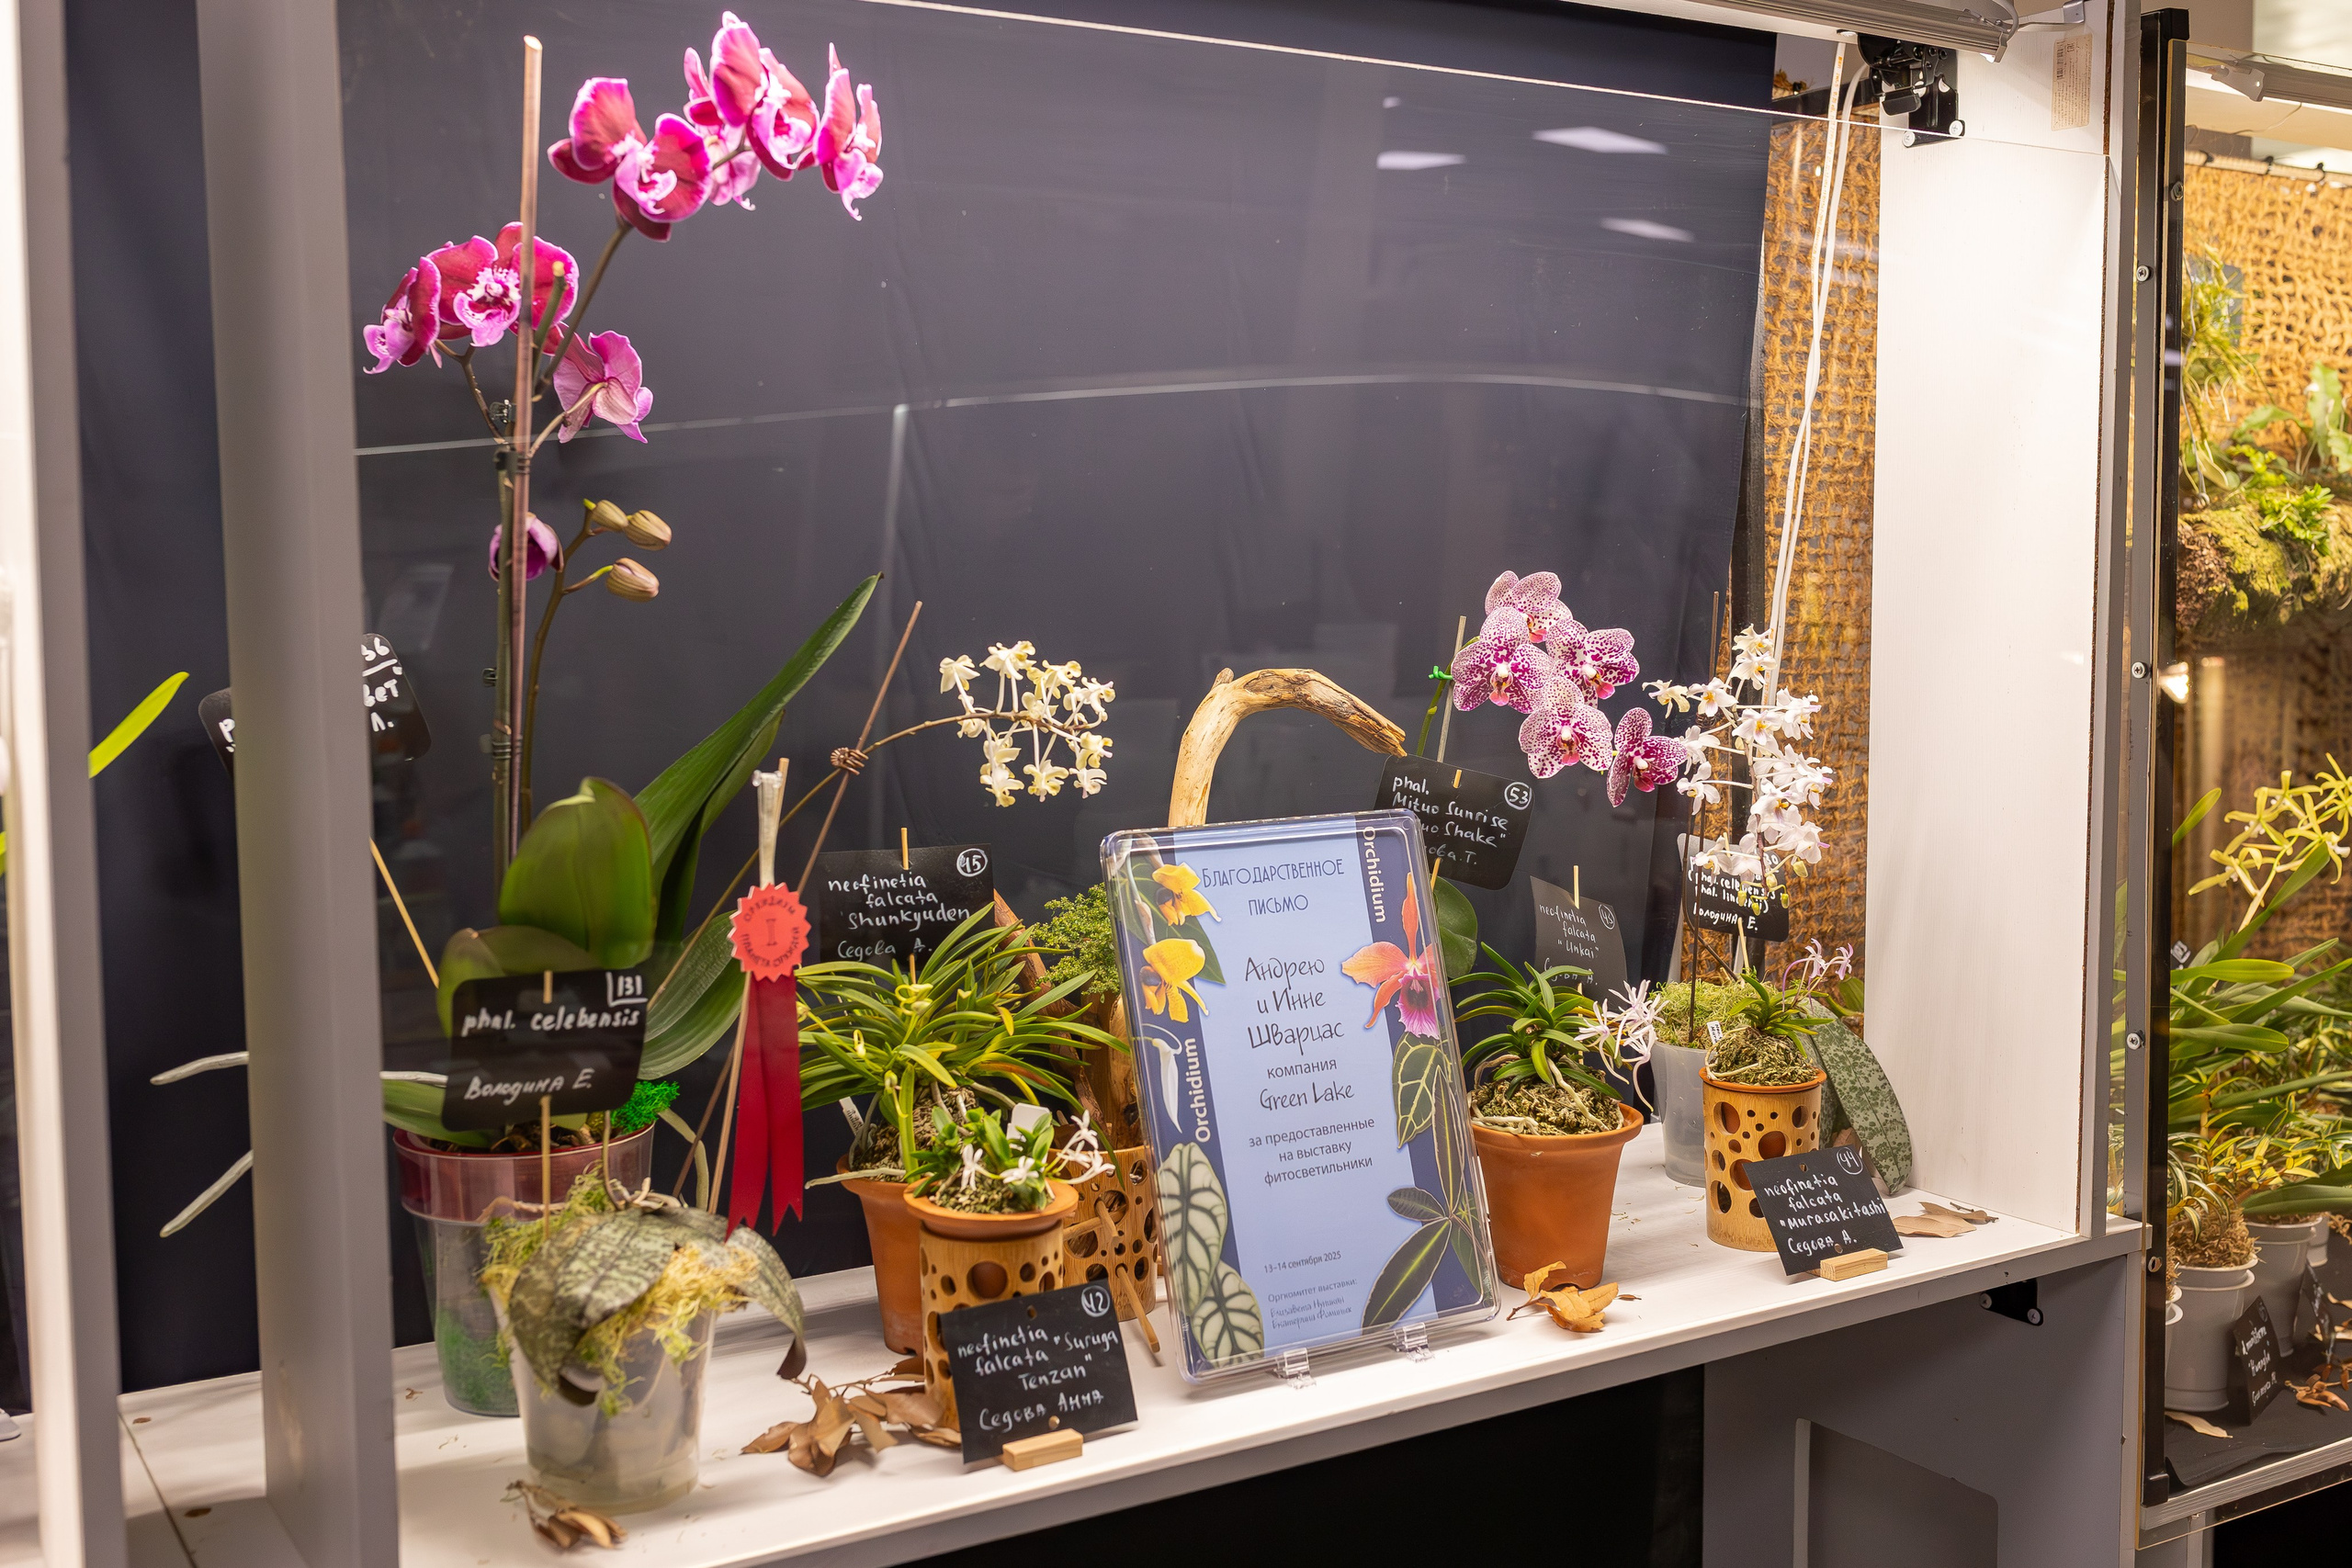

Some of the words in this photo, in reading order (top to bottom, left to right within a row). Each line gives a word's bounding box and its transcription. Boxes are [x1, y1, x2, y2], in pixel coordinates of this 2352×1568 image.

[1392, 775, 1430, 795] phal.
[1509, 787, 1529, 804] 53
[1445, 801, 1509, 830] Sunrise
[828, 871, 927, 895] neofinetia
[1362, 826, 1386, 923] Orchidium
[865, 889, 939, 908] falcata
[1562, 920, 1596, 943] falcata
[1245, 956, 1325, 989] Андрею
[616, 975, 643, 998] 131
[1257, 997, 1270, 1014] и
[1273, 987, 1327, 1012] Инне
[460, 1007, 516, 1038] phal.
[530, 1005, 640, 1032] celebensis
[1247, 1020, 1345, 1055] Шварцас
[1266, 1058, 1338, 1079] компания
[1185, 1037, 1211, 1144] Orchidium
[1260, 1088, 1308, 1111] Green
[1314, 1081, 1355, 1104] Lake
[1249, 1136, 1263, 1148] за
[1265, 1118, 1375, 1147] предоставленные
[1278, 1151, 1295, 1163] на
[1296, 1140, 1353, 1159] выставку
[1263, 1156, 1374, 1187] фитосветильники
[1764, 1173, 1838, 1197] neofinetia
[1788, 1190, 1843, 1213] falcata
[1287, 1255, 1323, 1273] сентября
[1323, 1250, 1342, 1263] 2025
[1268, 1287, 1317, 1303] Оргкомитет
[956, 1325, 1048, 1359] neofinetia
[975, 1348, 1049, 1377] falcata
